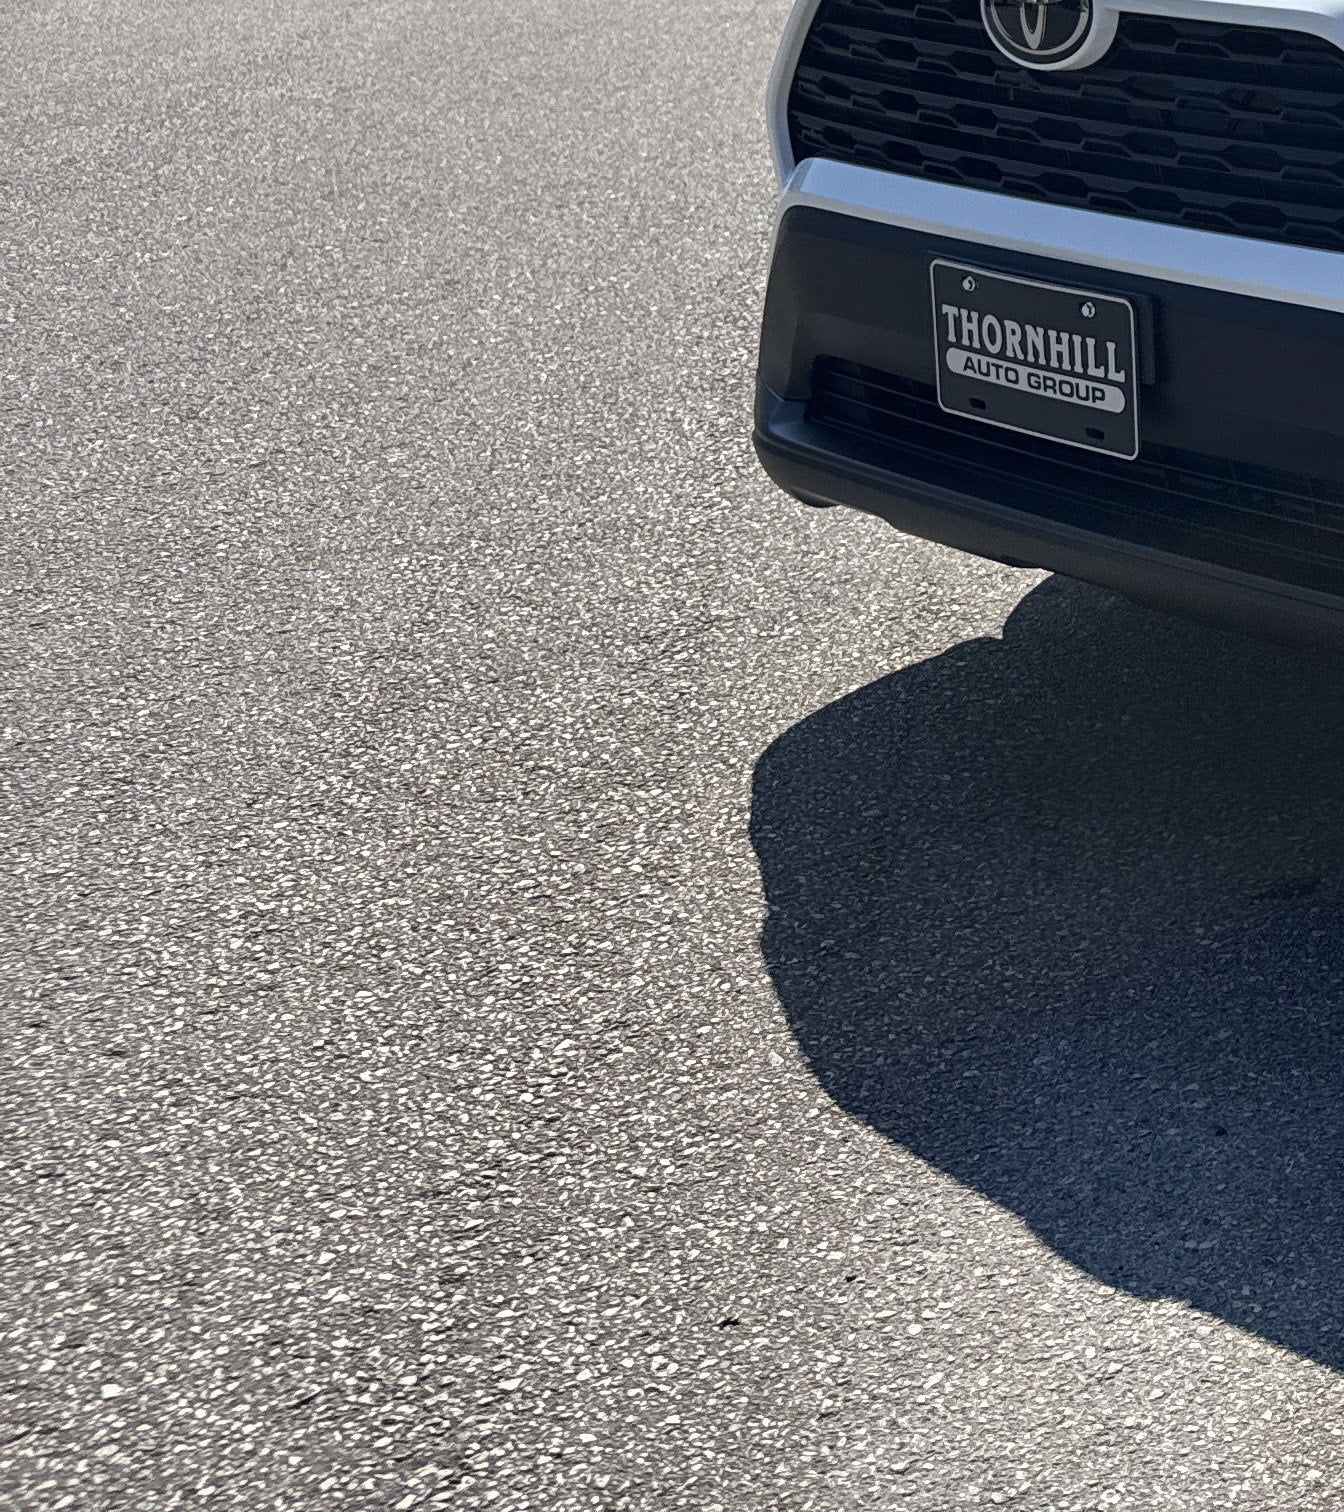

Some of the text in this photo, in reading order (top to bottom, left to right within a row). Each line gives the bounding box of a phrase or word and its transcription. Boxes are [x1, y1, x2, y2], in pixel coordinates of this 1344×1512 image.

[942, 303, 1125, 382] THORNHILL
[963, 355, 1106, 403] AUTO GROUP
